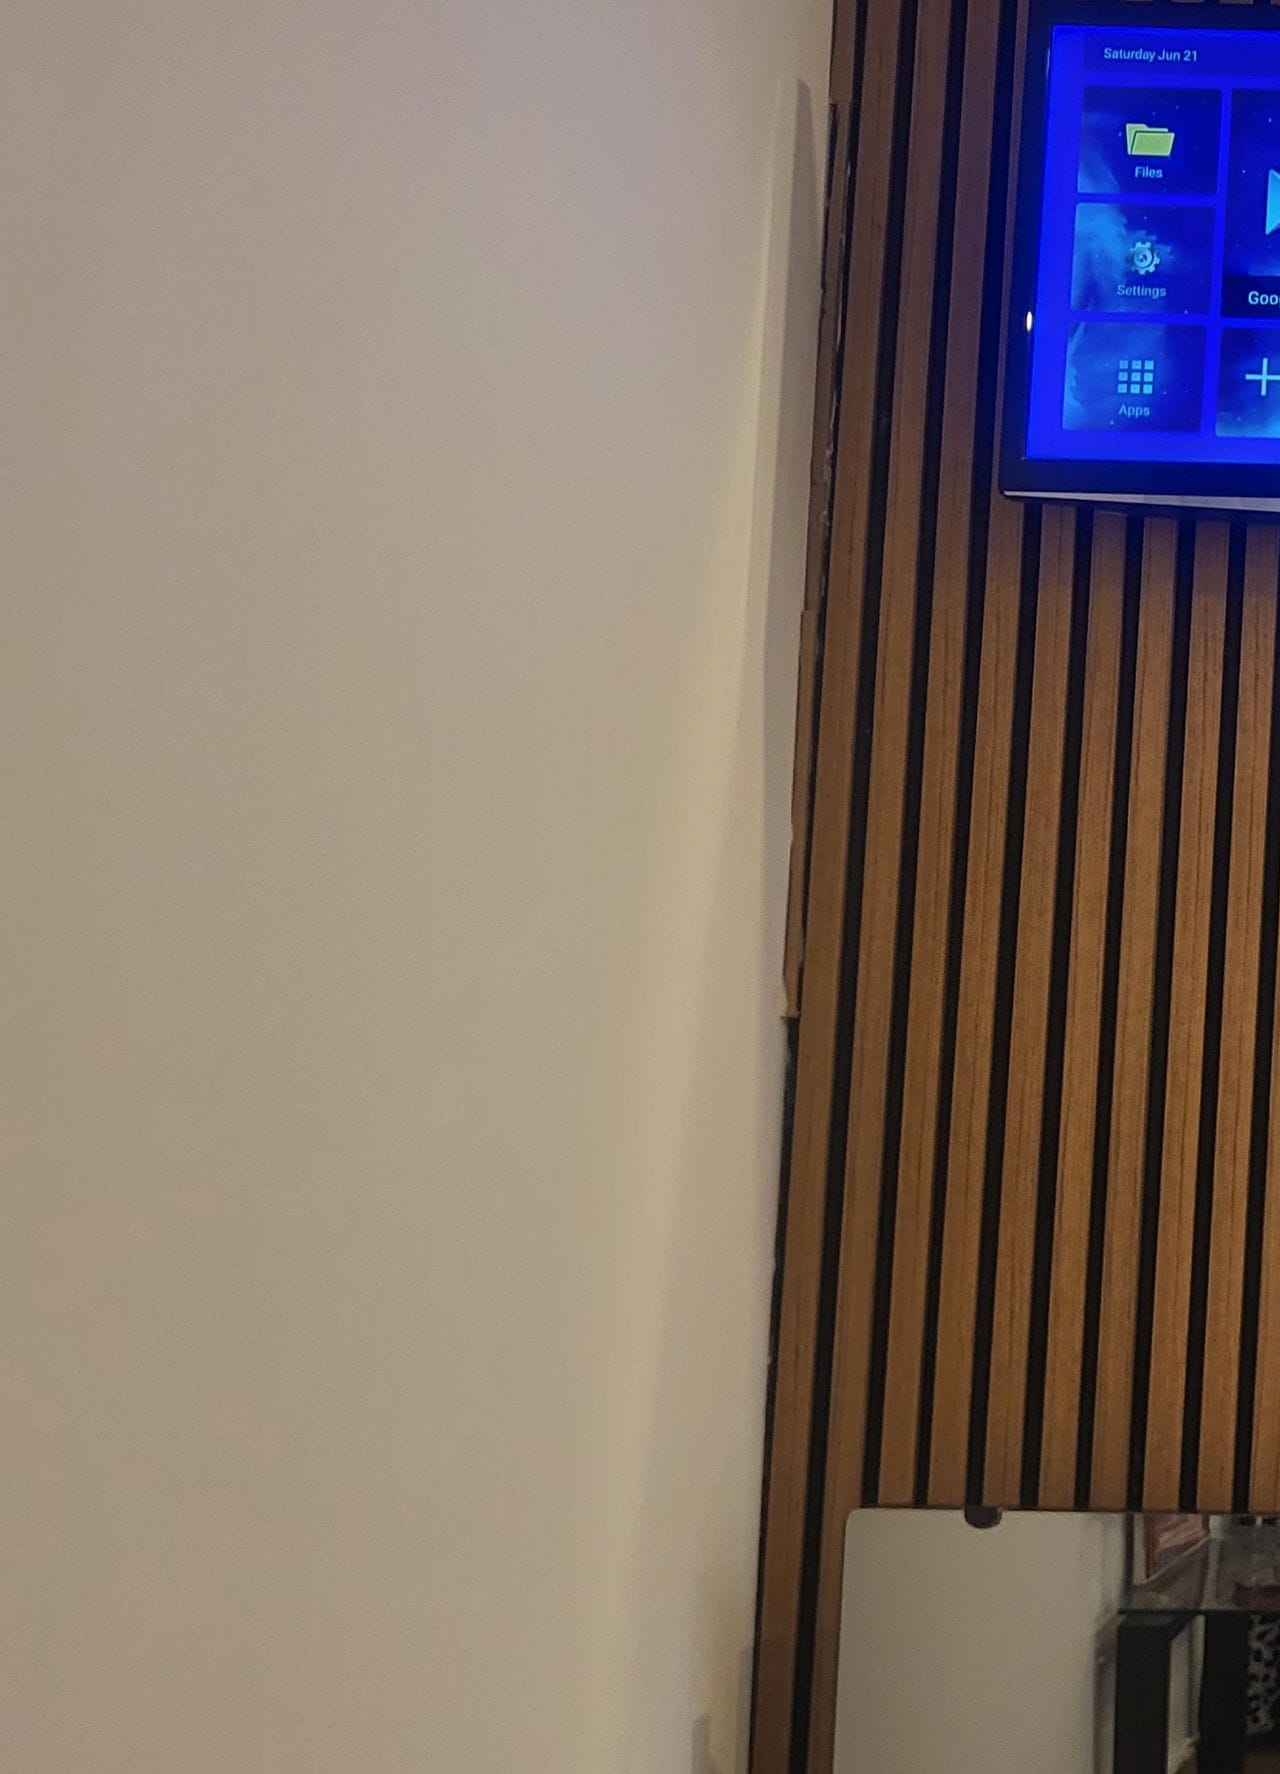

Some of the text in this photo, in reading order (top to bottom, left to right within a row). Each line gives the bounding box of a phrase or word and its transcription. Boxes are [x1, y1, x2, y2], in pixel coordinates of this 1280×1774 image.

[1103, 47, 1198, 63] Saturday Jun 21
[1134, 166, 1163, 179] Files
[1117, 284, 1167, 299] Settings
[1118, 403, 1151, 418] Apps
